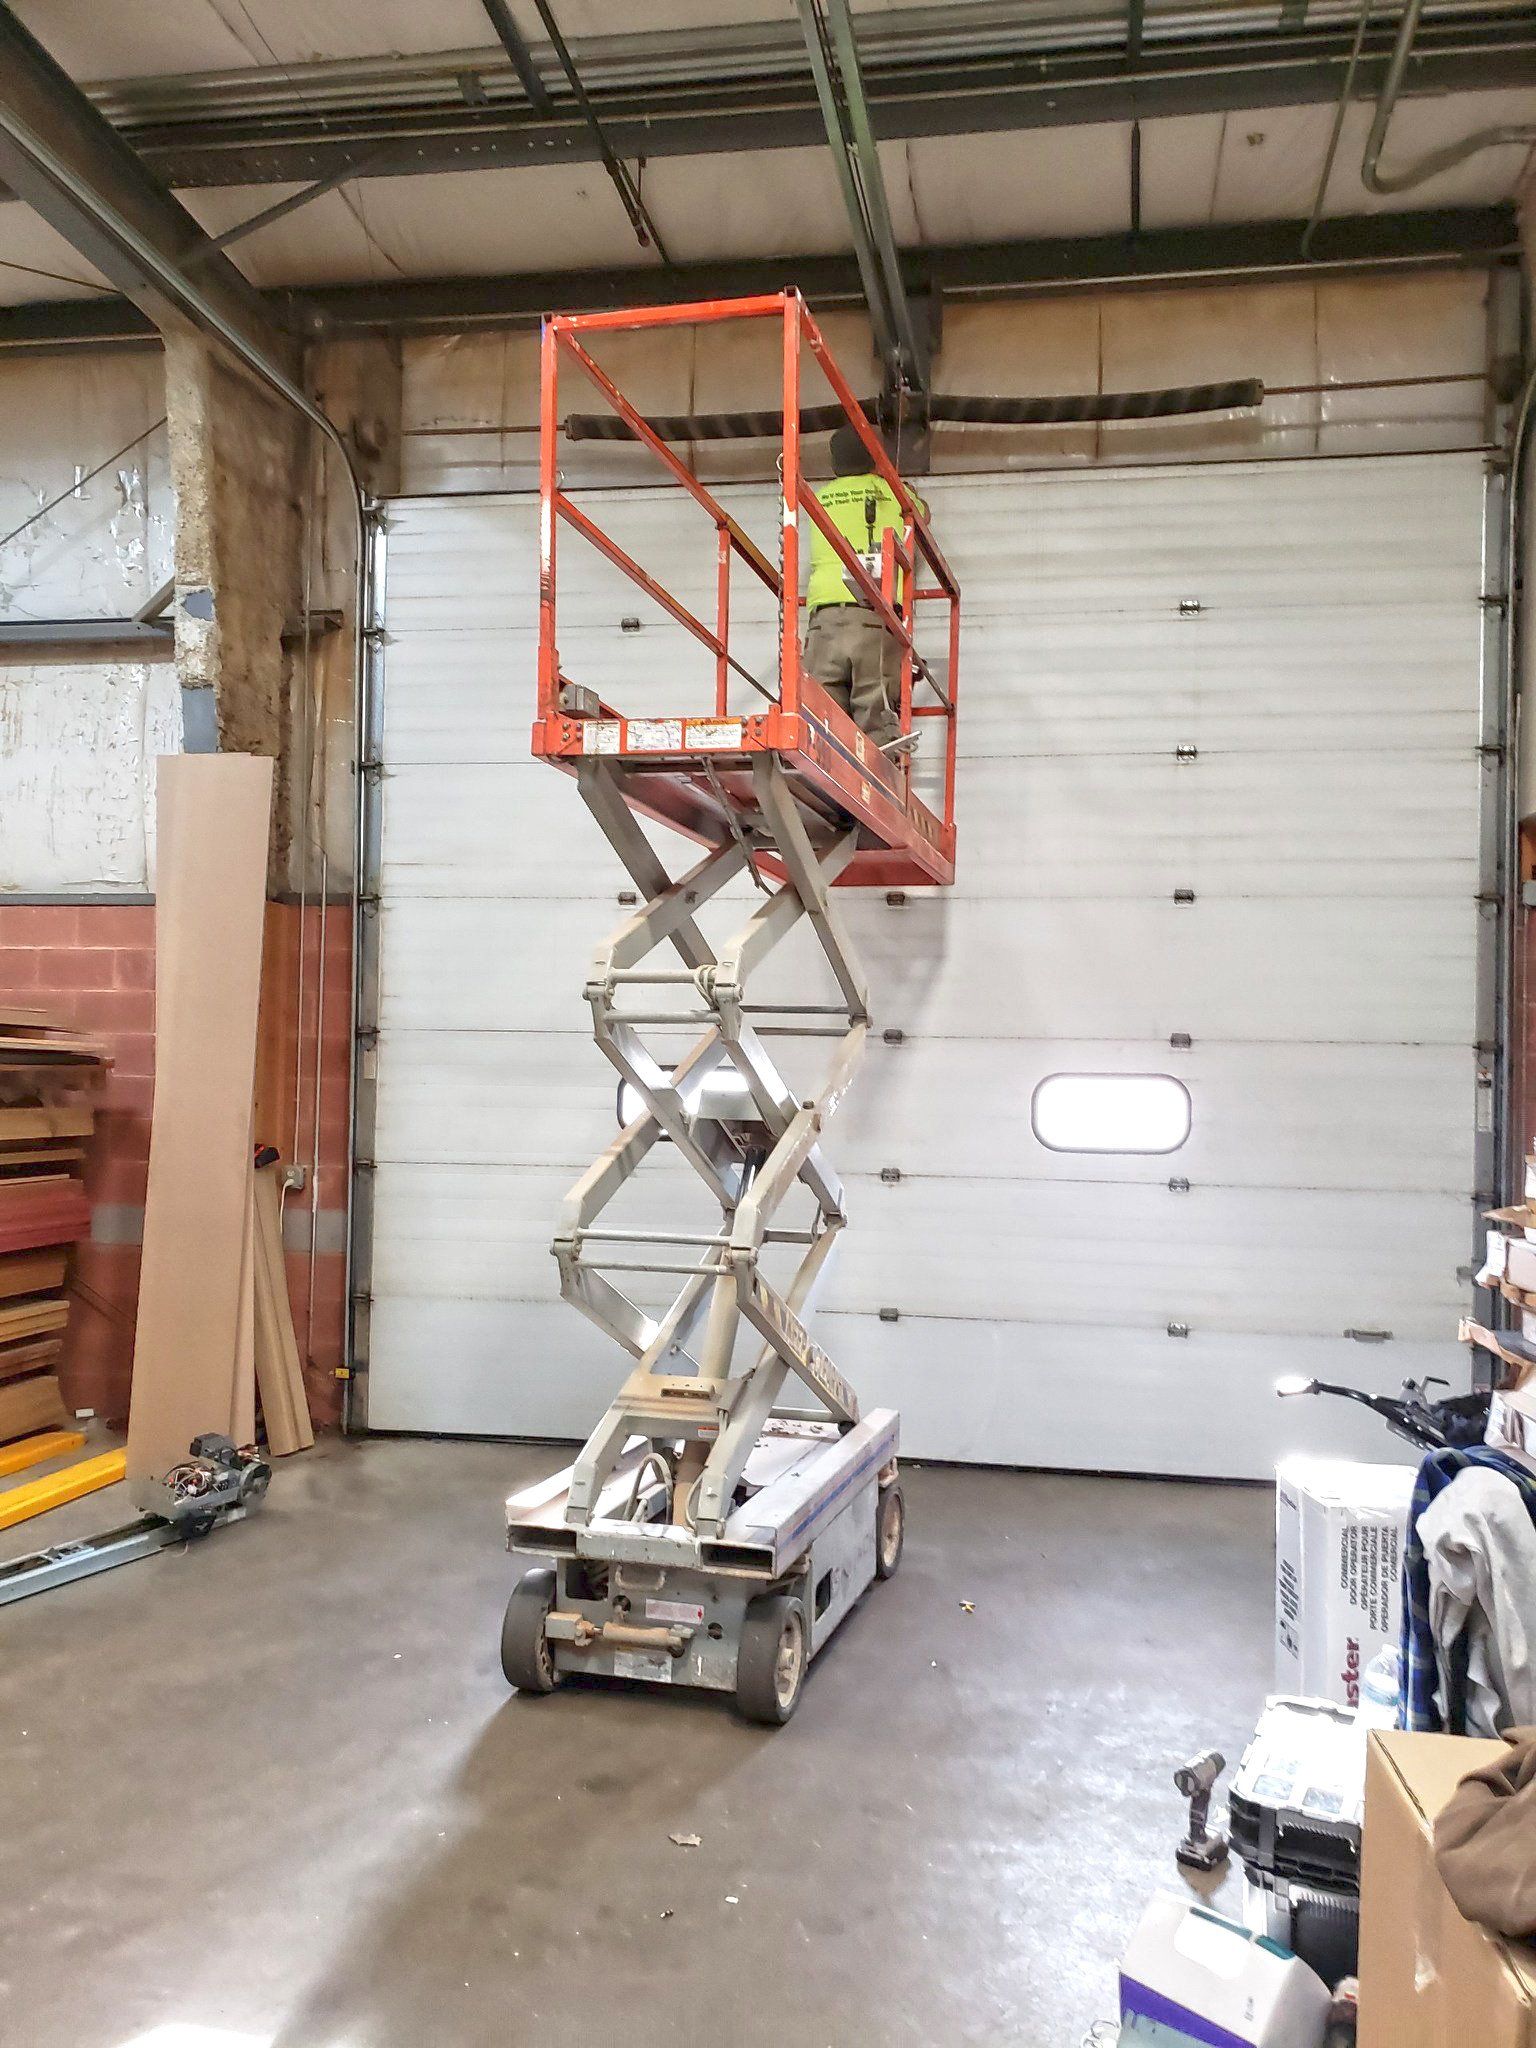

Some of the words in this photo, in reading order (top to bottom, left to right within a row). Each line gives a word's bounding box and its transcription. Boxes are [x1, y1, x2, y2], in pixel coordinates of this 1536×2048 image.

[1340, 1526, 1349, 1589] COMMERCIAL
[1350, 1525, 1358, 1575] OPERATOR
[1361, 1525, 1369, 1552] POUR
[1369, 1525, 1378, 1596] COMMERCIALE
[1381, 1526, 1389, 1563] PUERTA
[1390, 1526, 1398, 1583] COMERCIAL
[1350, 1577, 1358, 1605] DOOR
[1360, 1554, 1369, 1611] OPÉRATEUR
[1381, 1565, 1389, 1578] DE
[1369, 1598, 1377, 1631] PORTE
[1380, 1581, 1389, 1634] OPERADOR
